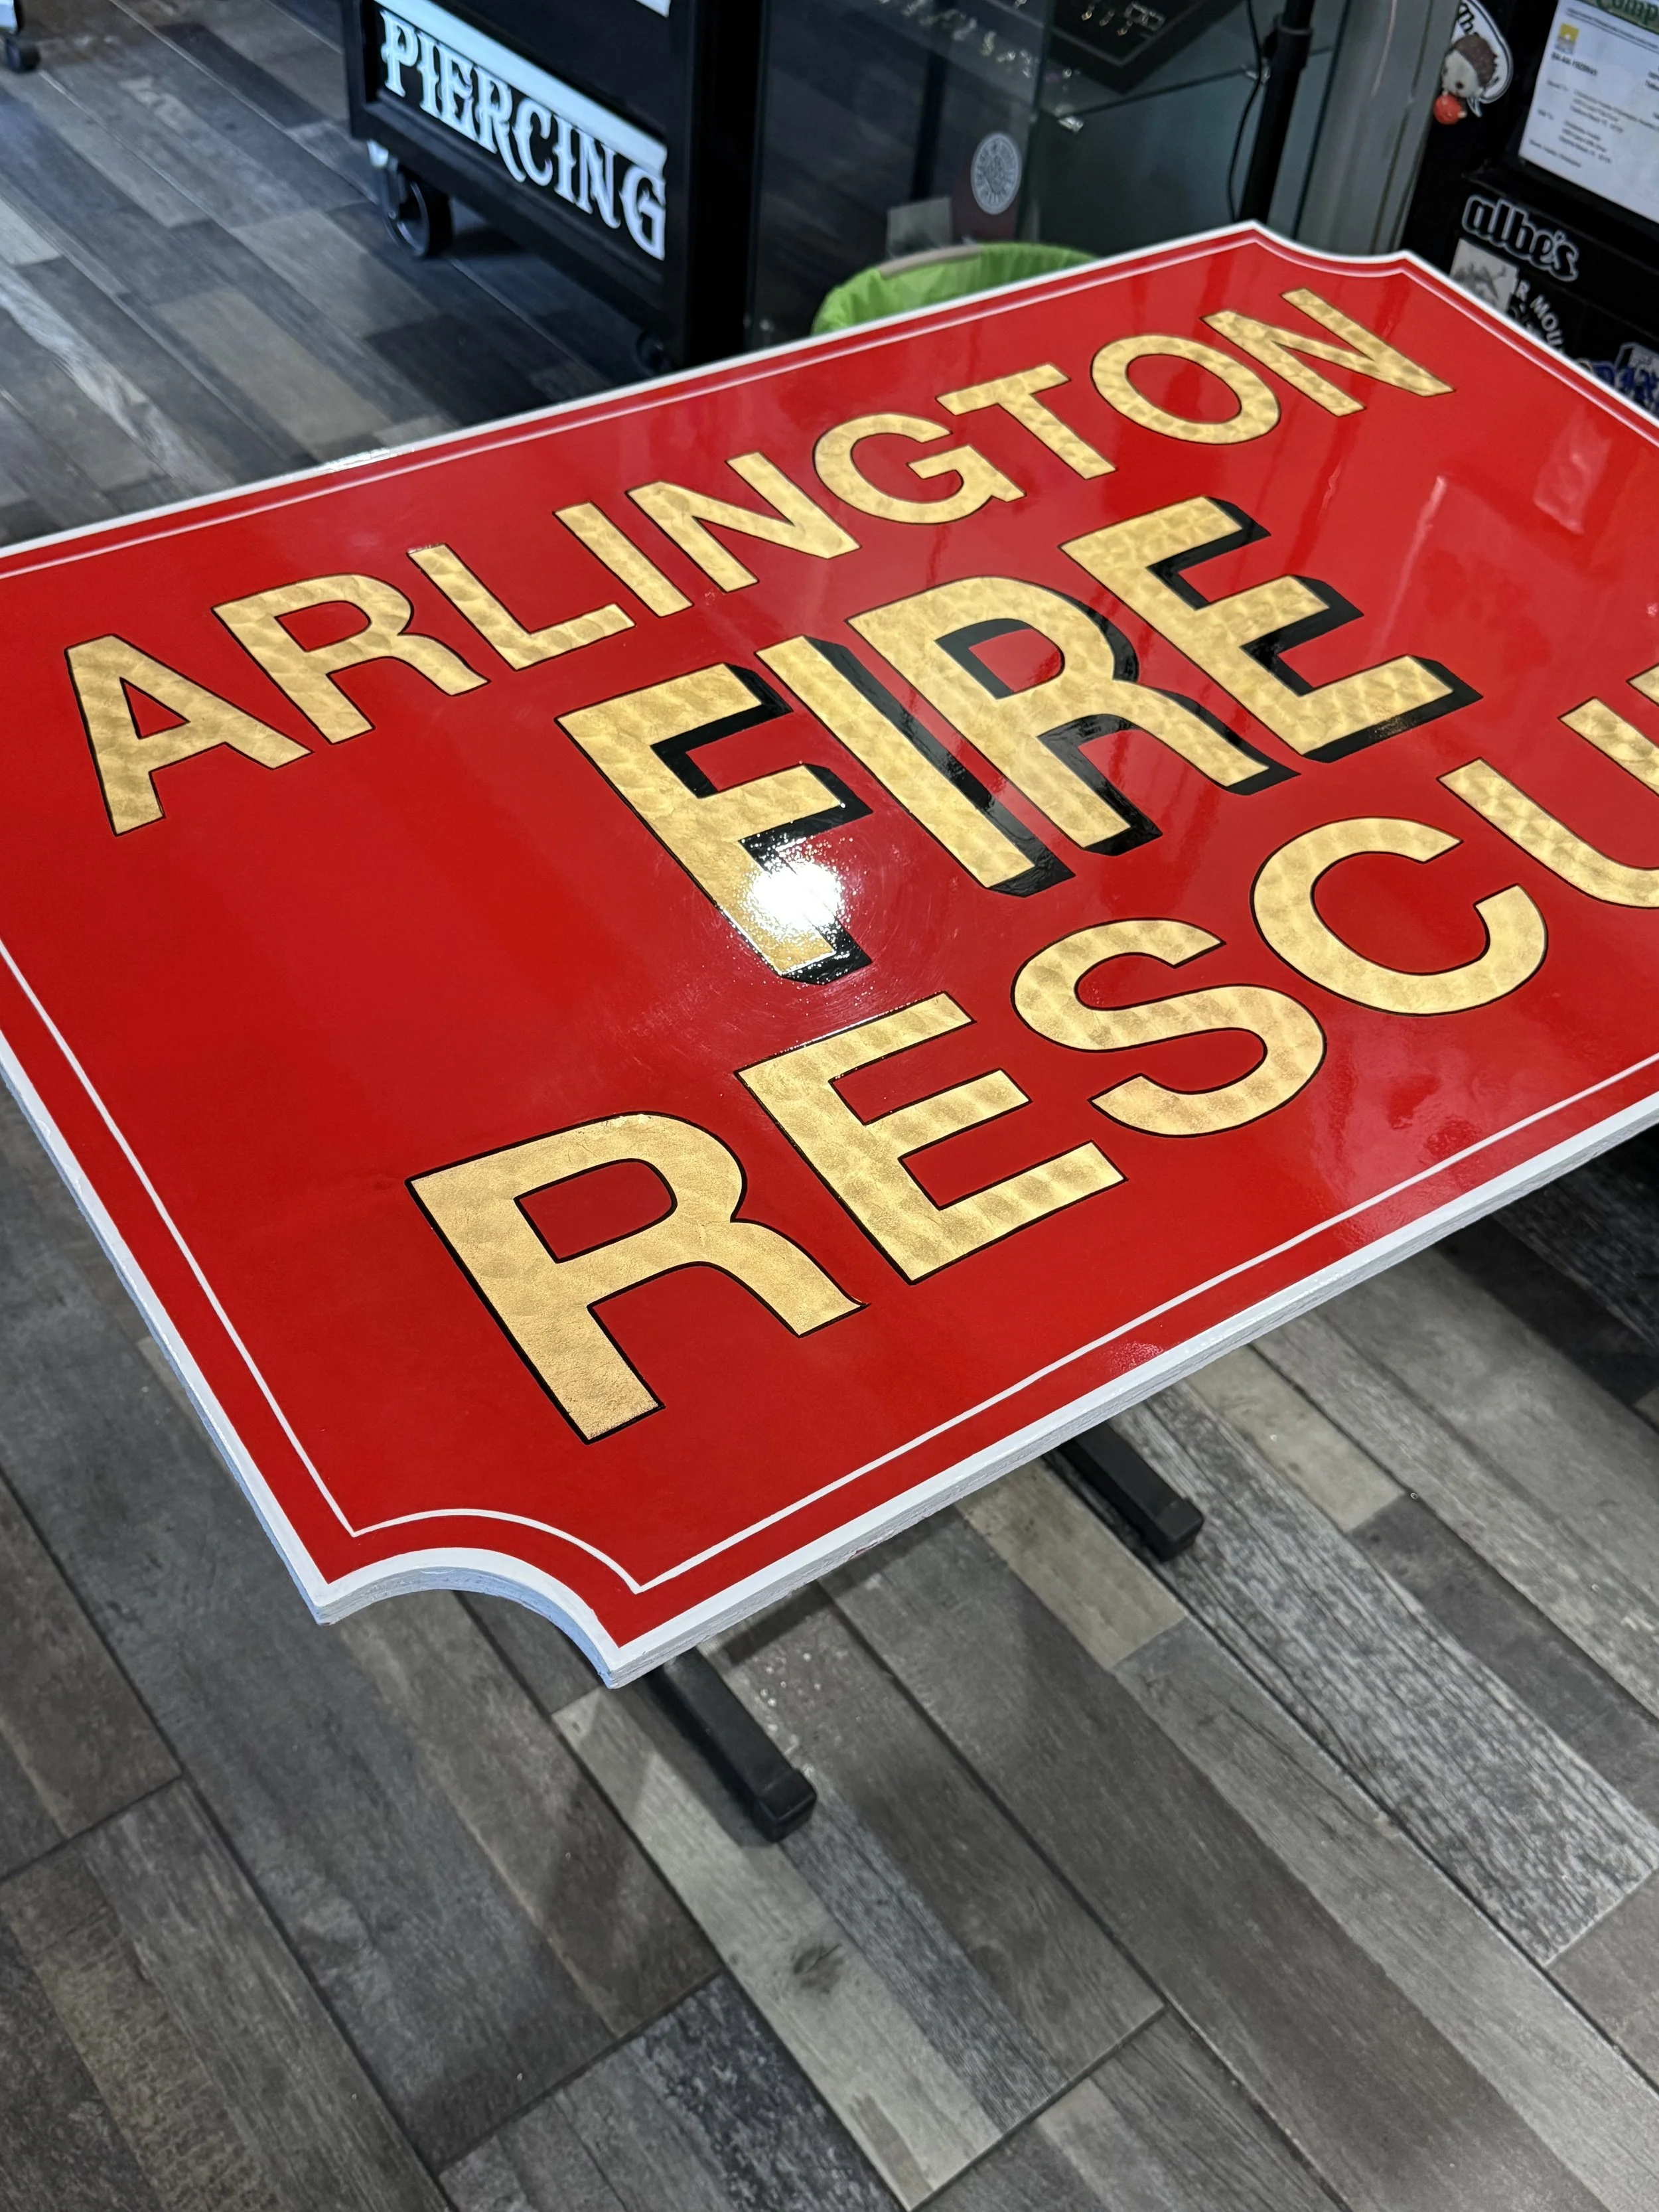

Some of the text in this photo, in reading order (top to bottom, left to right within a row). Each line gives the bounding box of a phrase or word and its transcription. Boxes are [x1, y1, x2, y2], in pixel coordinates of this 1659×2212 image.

[380, 9, 667, 261] PIERCING
[1461, 194, 1579, 283] albe's
[64, 287, 1455, 837] ARLINGTON
[555, 495, 1484, 984] FIRE
[408, 662, 1659, 1445] RESCU
